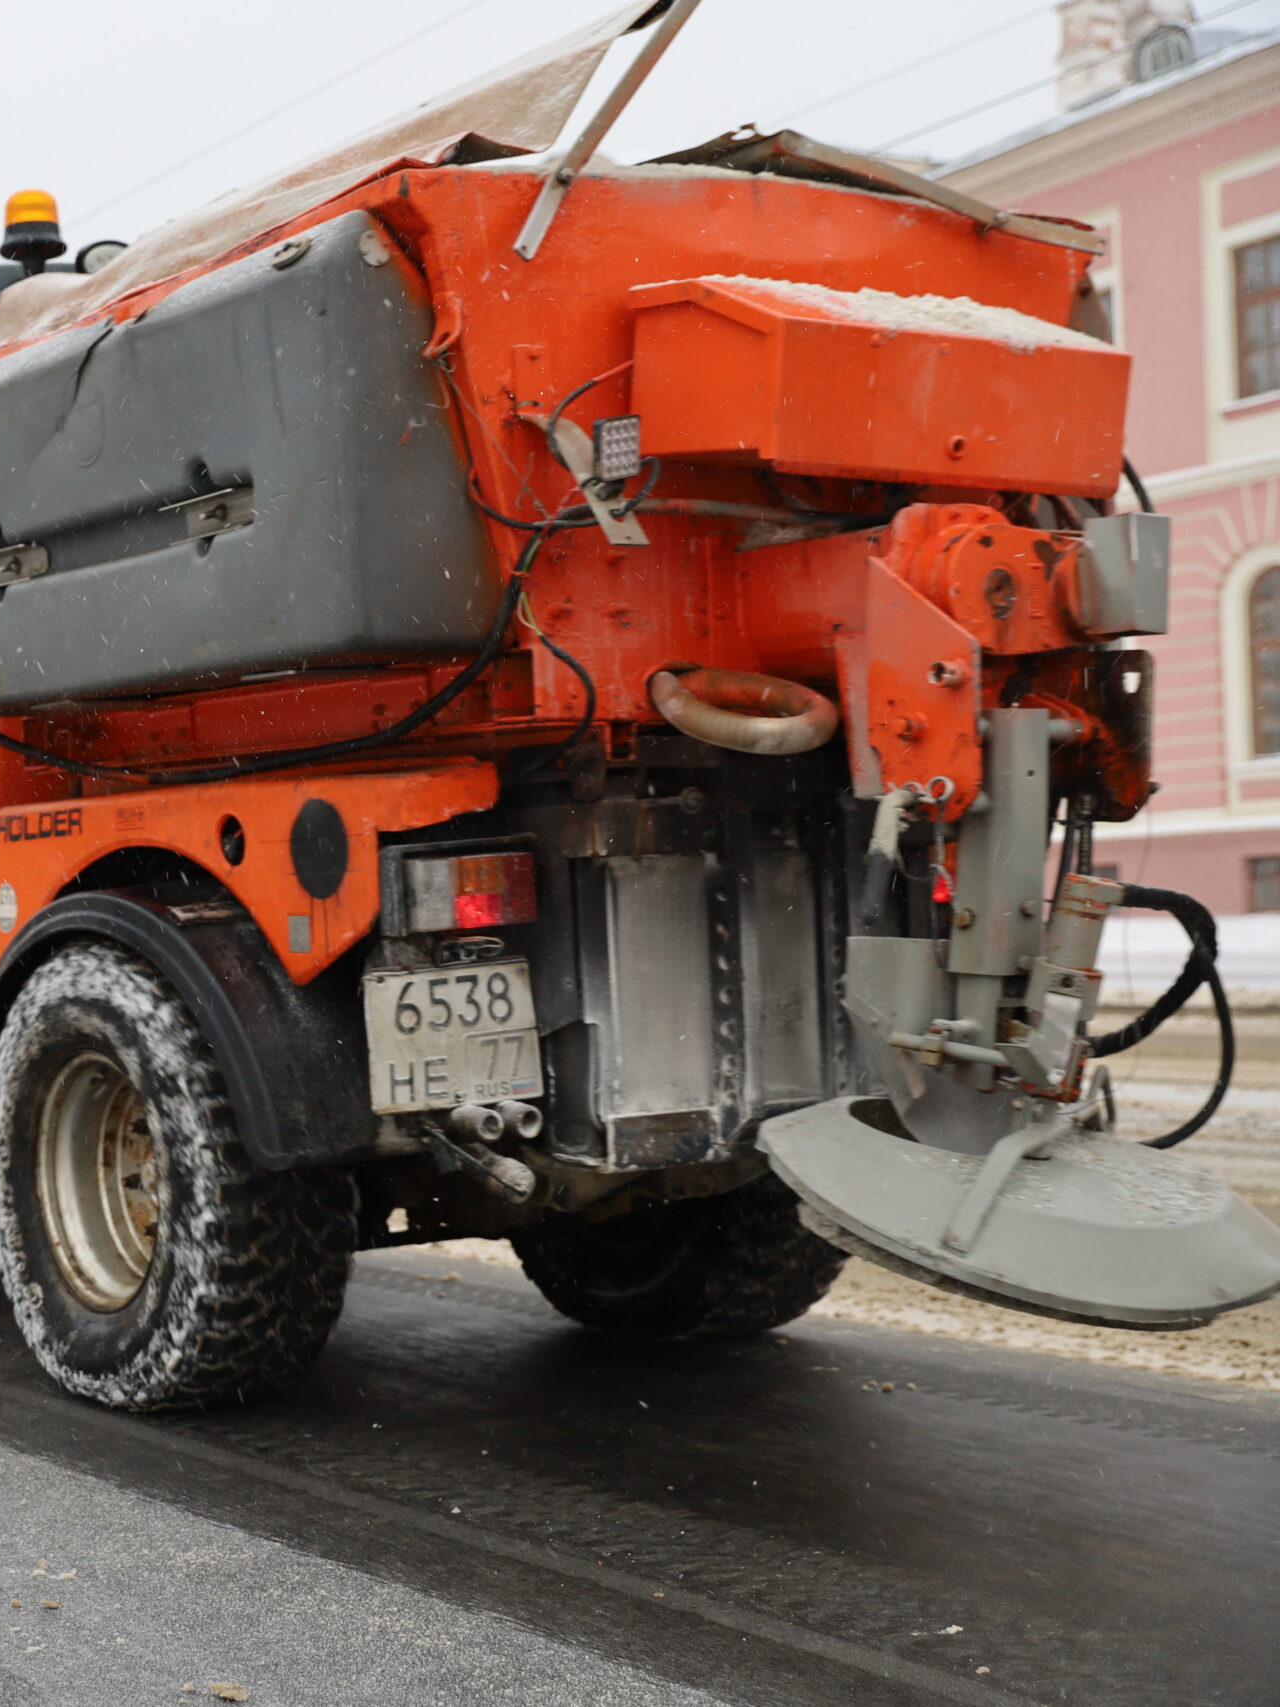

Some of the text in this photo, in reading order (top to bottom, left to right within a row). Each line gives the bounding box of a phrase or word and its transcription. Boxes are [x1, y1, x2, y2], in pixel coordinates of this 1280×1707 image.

[395, 972, 513, 1034] 6538
[480, 1036, 524, 1080] 77
[390, 1058, 449, 1104] HE
[475, 1081, 512, 1098] RUS
